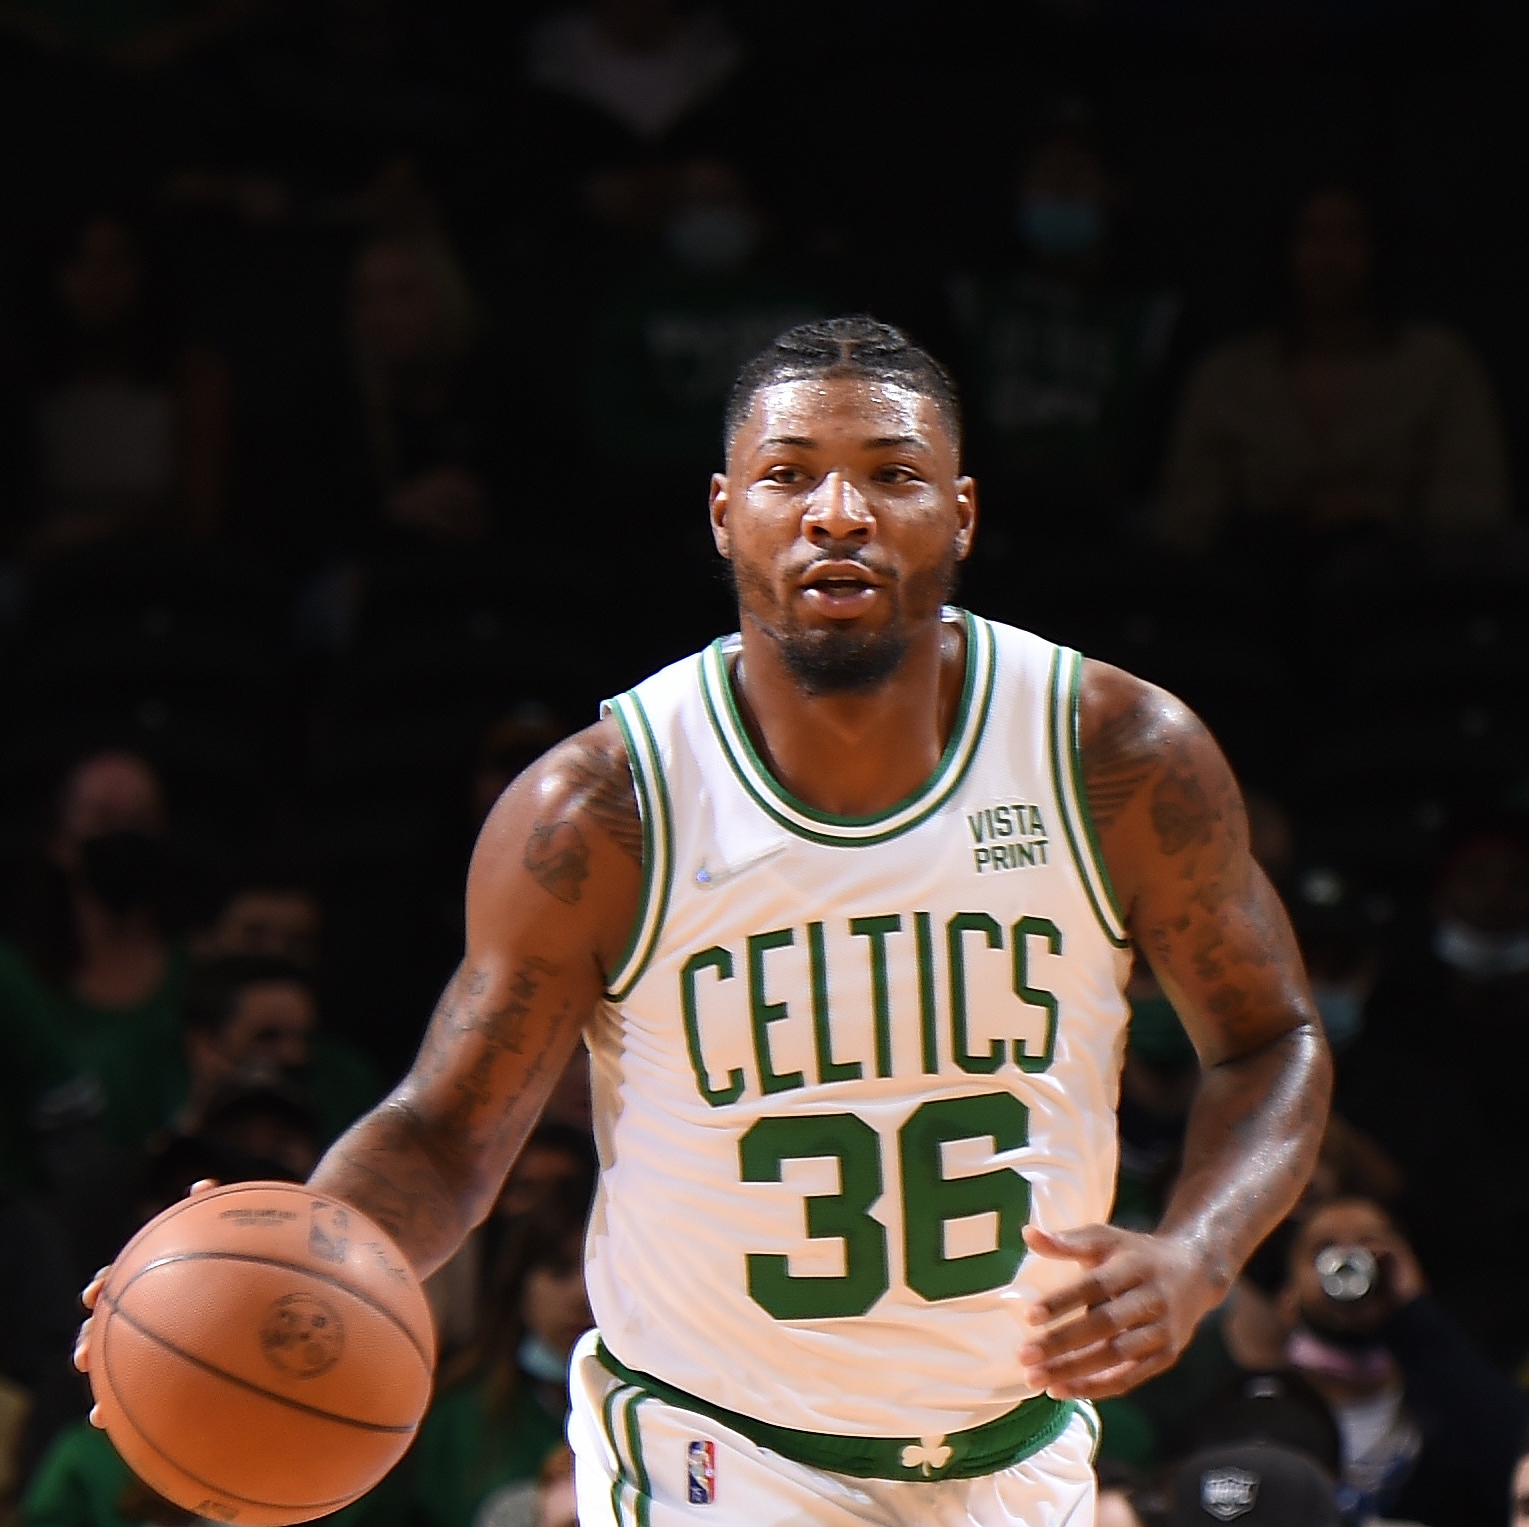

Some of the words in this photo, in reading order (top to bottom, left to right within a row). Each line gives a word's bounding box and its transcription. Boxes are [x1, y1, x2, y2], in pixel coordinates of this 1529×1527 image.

[966, 804, 1047, 843] VISTA
[973, 839, 1049, 874] PRINT
[679, 911, 1062, 1107] CELTICS
[738, 1091, 1034, 1321] 36
